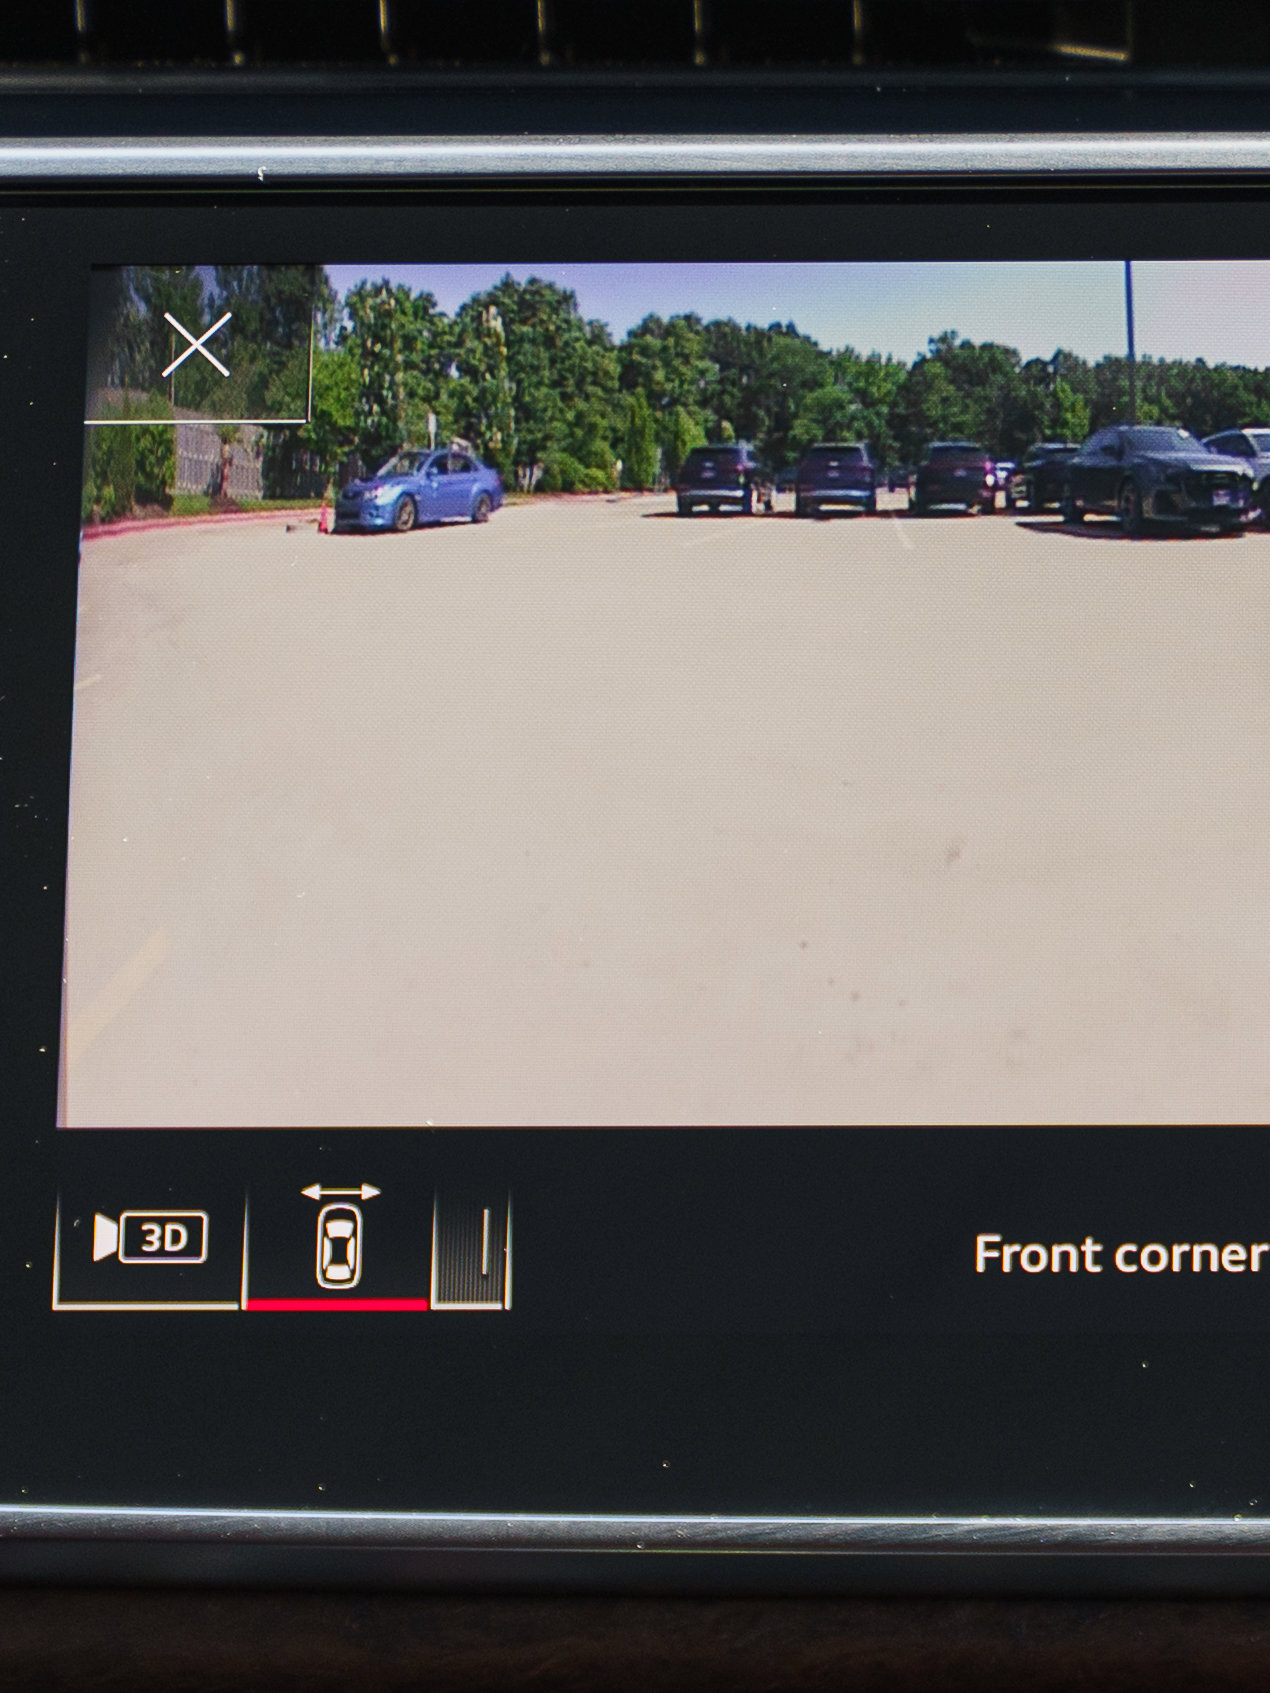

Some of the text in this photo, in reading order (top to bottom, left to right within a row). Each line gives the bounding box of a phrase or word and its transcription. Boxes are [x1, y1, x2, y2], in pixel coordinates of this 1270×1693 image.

[141, 1222, 188, 1252] 3D
[976, 1234, 1270, 1273] Front corner
